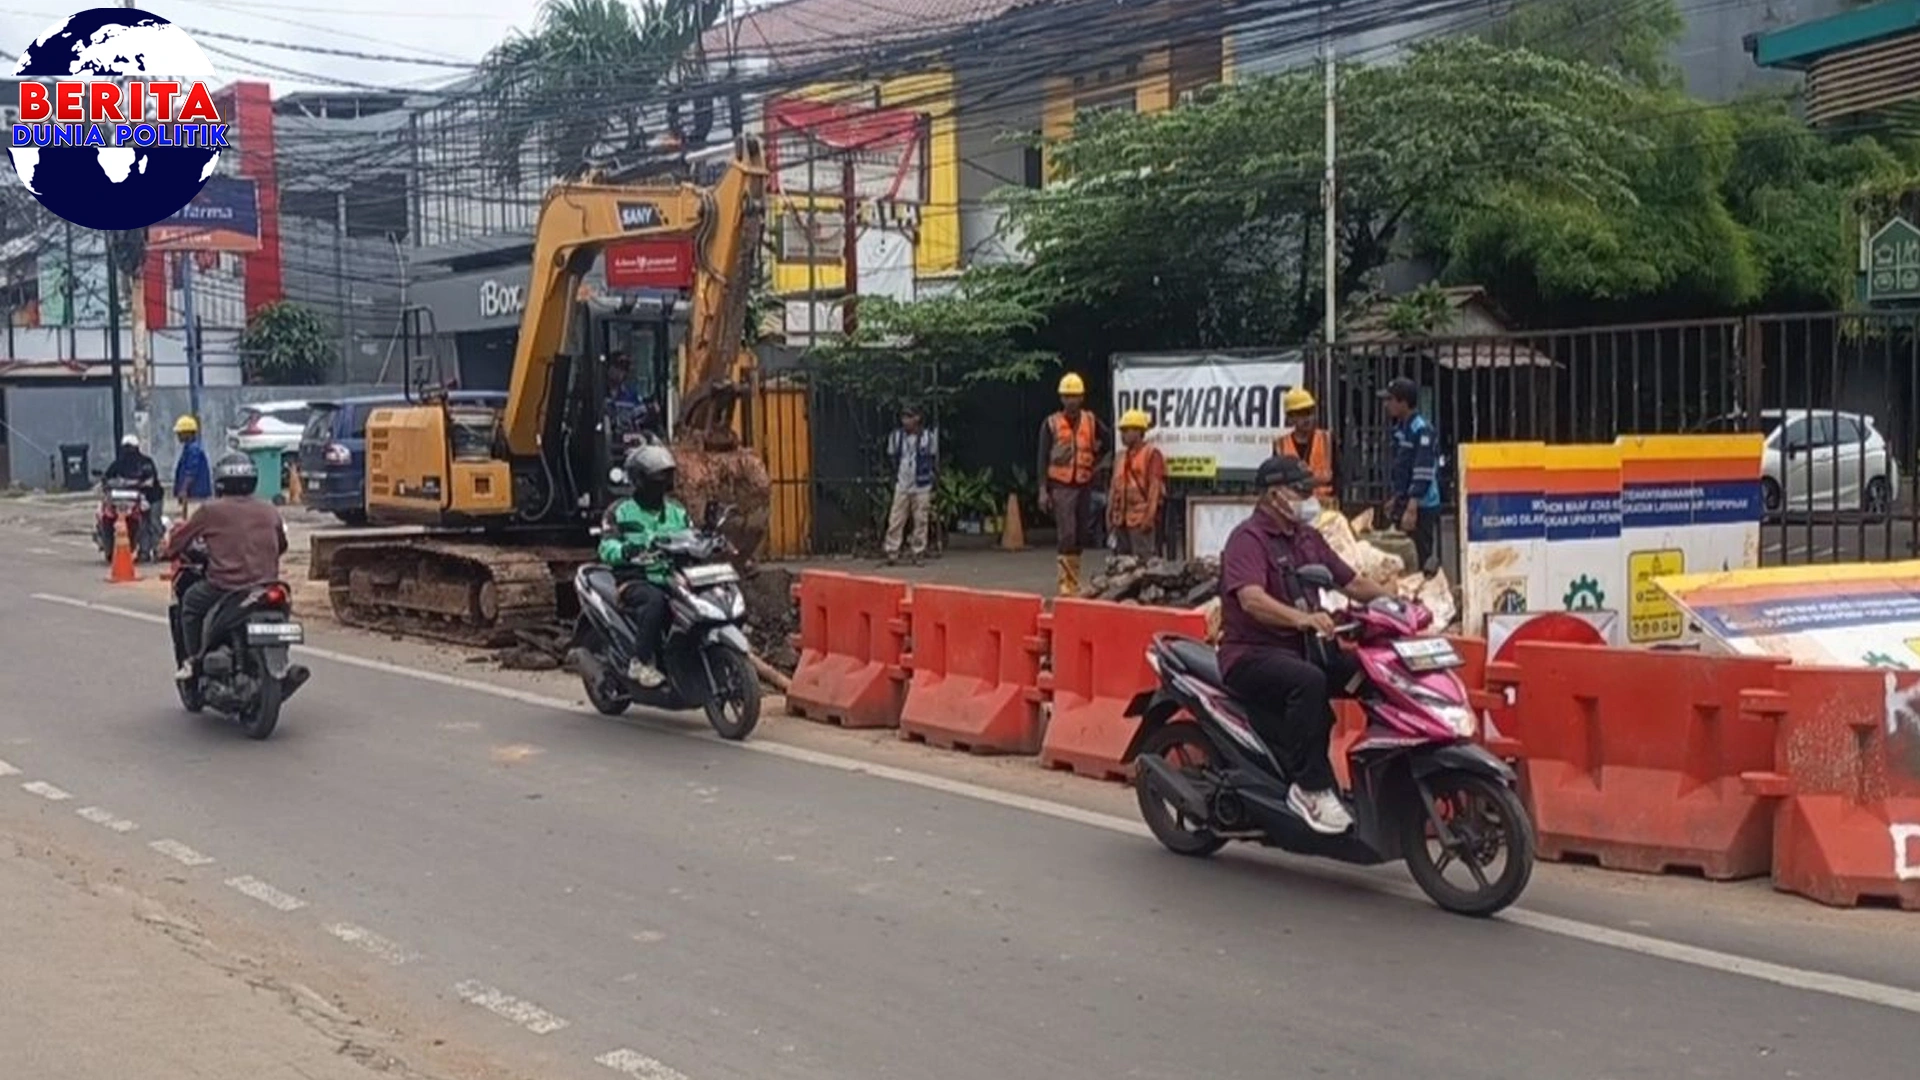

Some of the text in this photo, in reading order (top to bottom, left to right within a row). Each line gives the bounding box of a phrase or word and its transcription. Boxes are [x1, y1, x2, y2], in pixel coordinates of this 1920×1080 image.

[183, 203, 234, 219] farma
[621, 206, 654, 225] SANY
[480, 280, 522, 317] iBox
